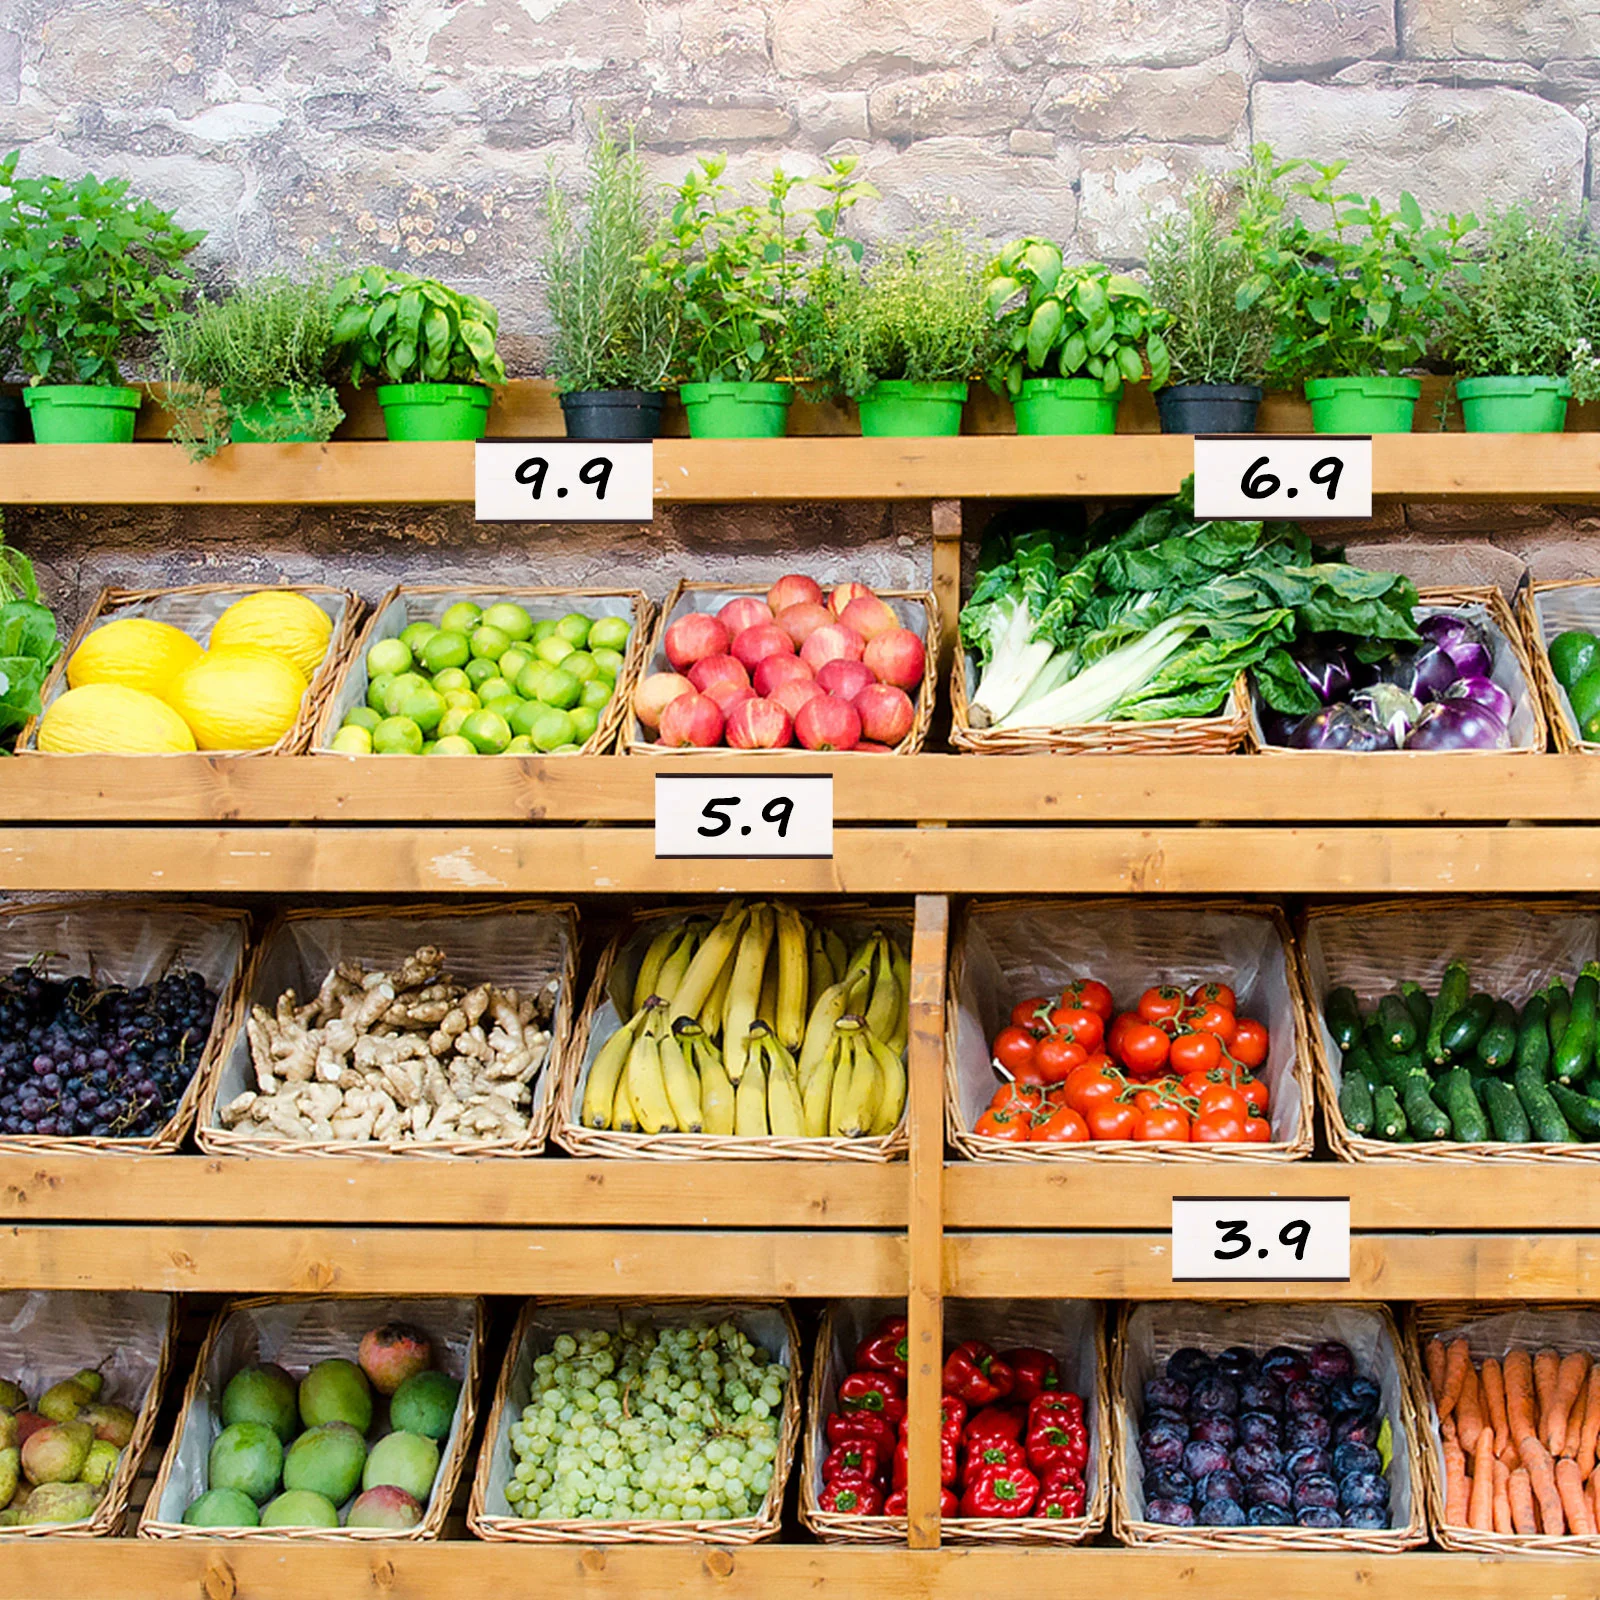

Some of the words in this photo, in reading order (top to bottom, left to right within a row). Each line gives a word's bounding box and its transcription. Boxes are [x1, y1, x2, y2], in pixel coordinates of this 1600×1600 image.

[515, 457, 613, 500] 9.9
[1240, 456, 1344, 501] 6.9
[697, 796, 795, 838] 5.9
[1213, 1219, 1312, 1261] 3.9
